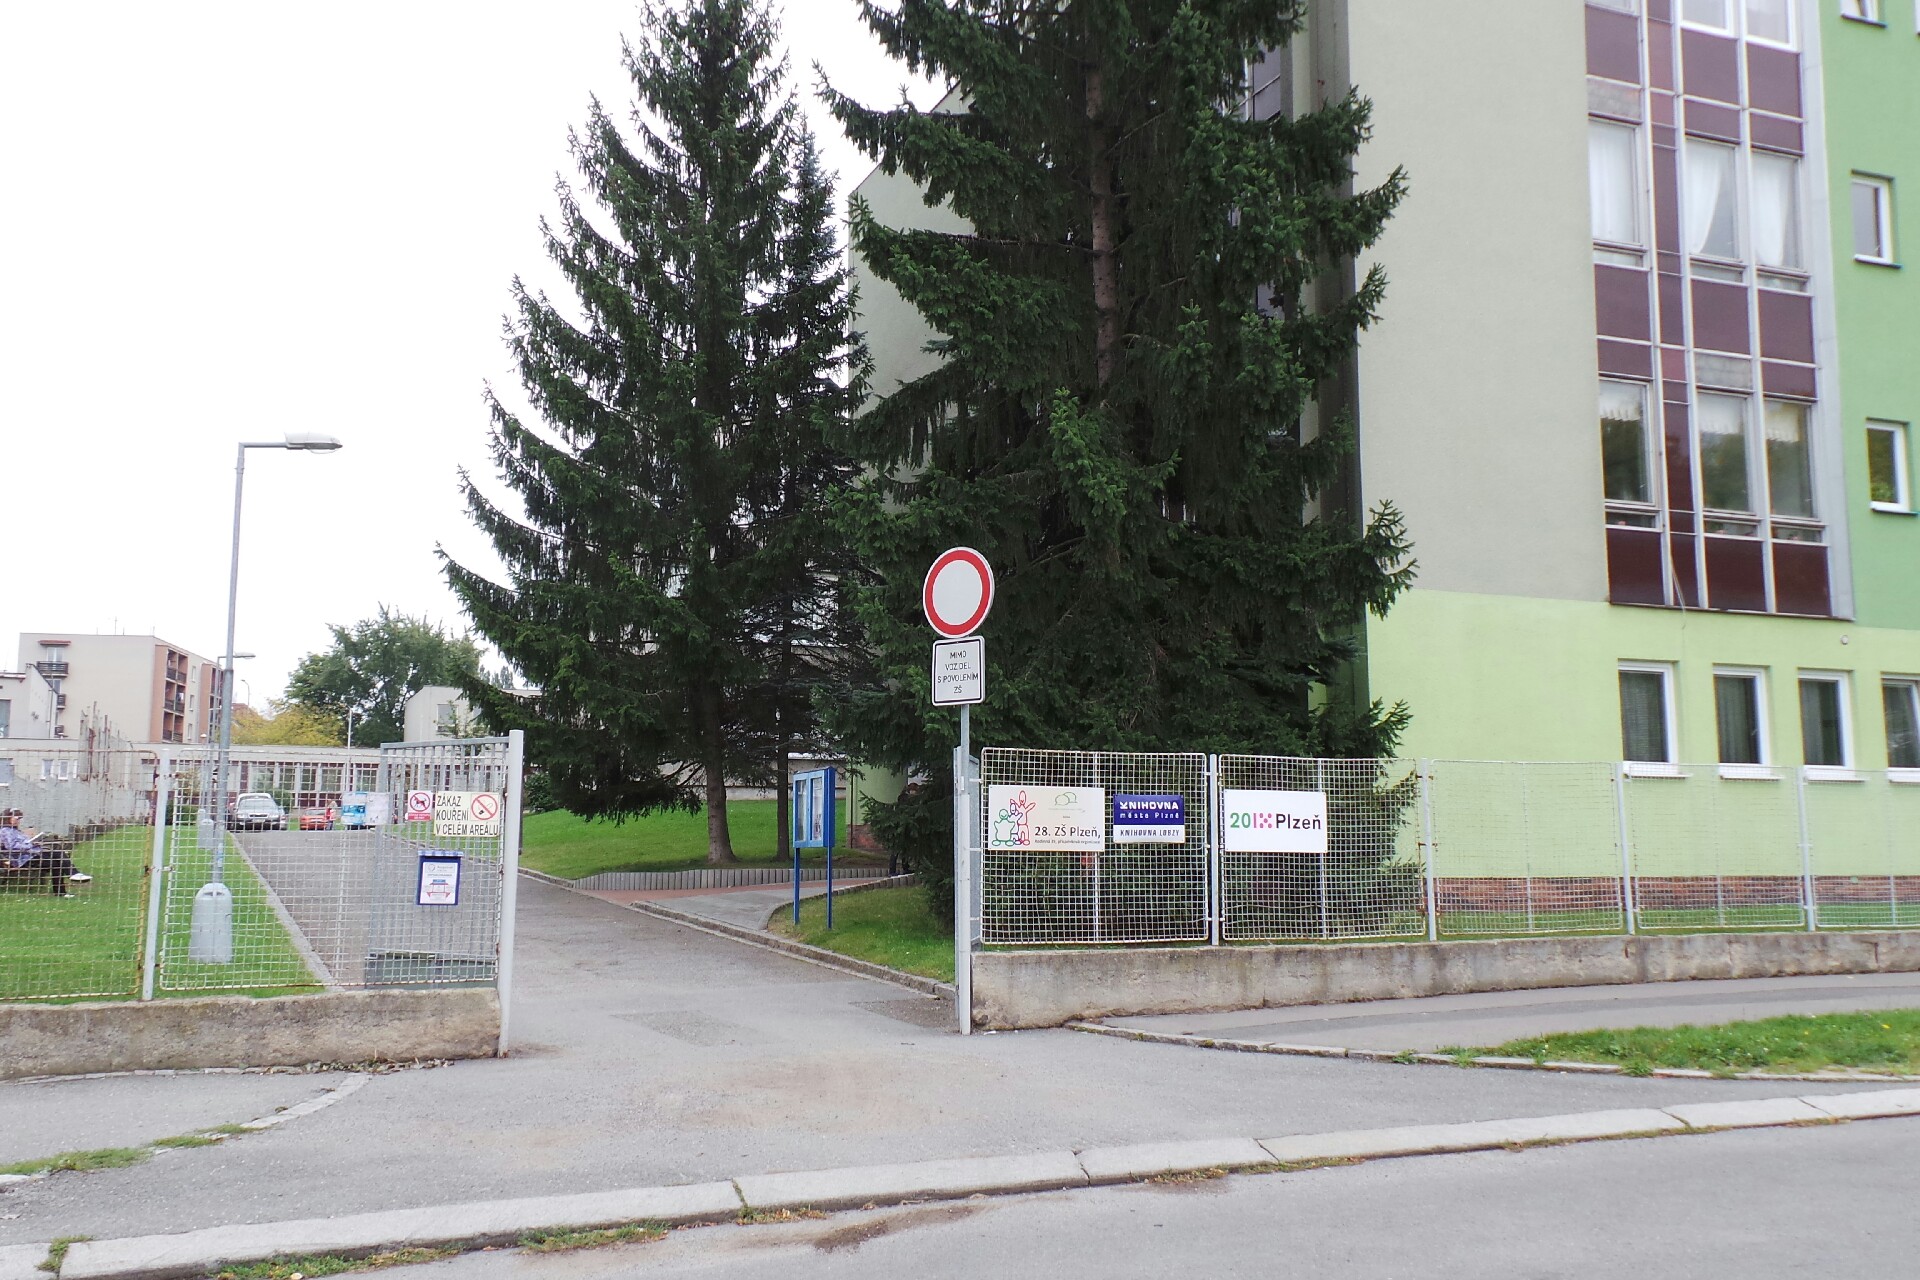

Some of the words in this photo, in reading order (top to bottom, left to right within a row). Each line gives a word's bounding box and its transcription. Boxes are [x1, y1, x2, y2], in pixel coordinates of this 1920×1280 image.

[950, 650, 966, 659] MIMO
[945, 662, 971, 671] VOZDEL
[437, 793, 462, 807] ZÁKAZ
[1120, 801, 1179, 810] KNIHOVNA
[436, 807, 469, 821] KOUŘENÍ
[436, 824, 441, 834] V
[442, 822, 468, 835] CELÉM
[469, 822, 499, 836] AREÁLU
[1275, 814, 1321, 830] Plzeň
[1034, 826, 1051, 837] 28.
[1054, 823, 1067, 837] ZŠ
[1069, 825, 1101, 839] Plzeň,
[1120, 829, 1157, 837] KNIHOVNA
[1159, 829, 1180, 837] LOBZY
